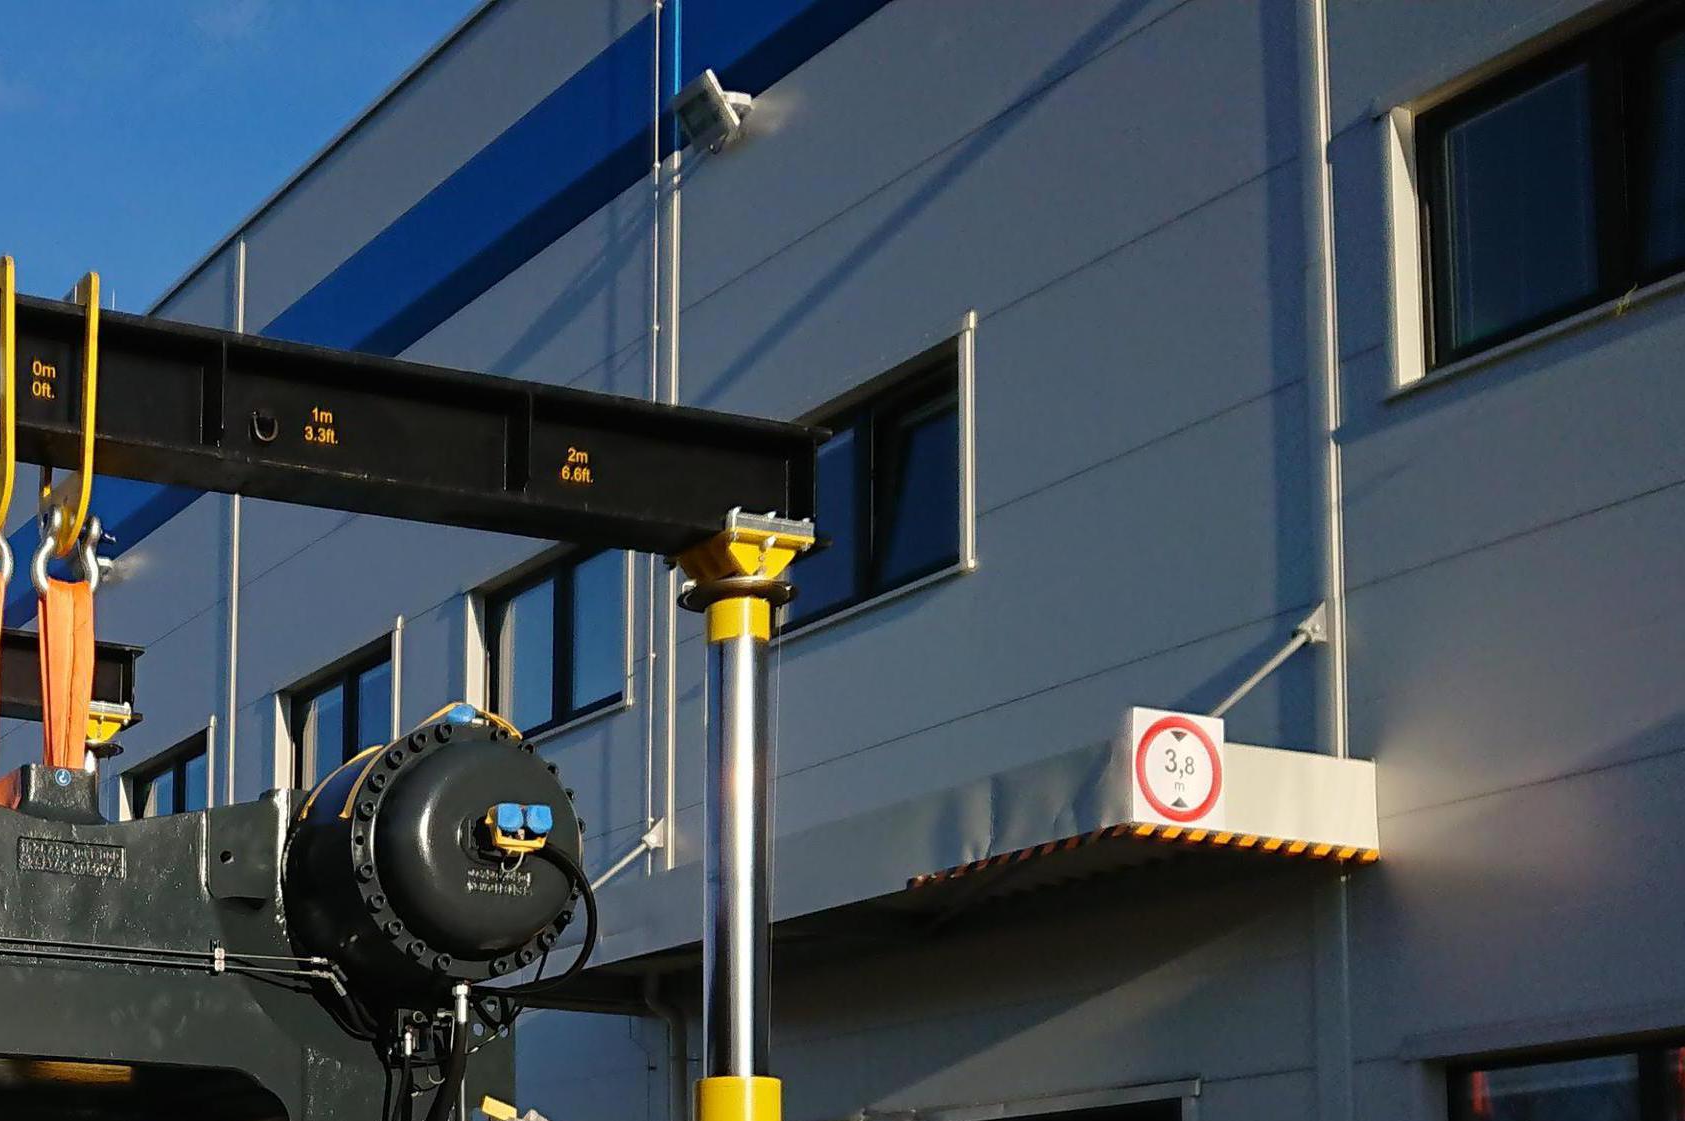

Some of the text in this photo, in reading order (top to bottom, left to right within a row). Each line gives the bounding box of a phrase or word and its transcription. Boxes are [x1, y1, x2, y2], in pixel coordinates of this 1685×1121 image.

[32, 360, 56, 379] 0m
[312, 405, 333, 424] 1m
[304, 425, 338, 445] 3.3ft.
[567, 446, 588, 464] 2m
[561, 465, 594, 483] 6.6ft.
[1164, 748, 1195, 779] 3,8
[1173, 781, 1185, 792] m
